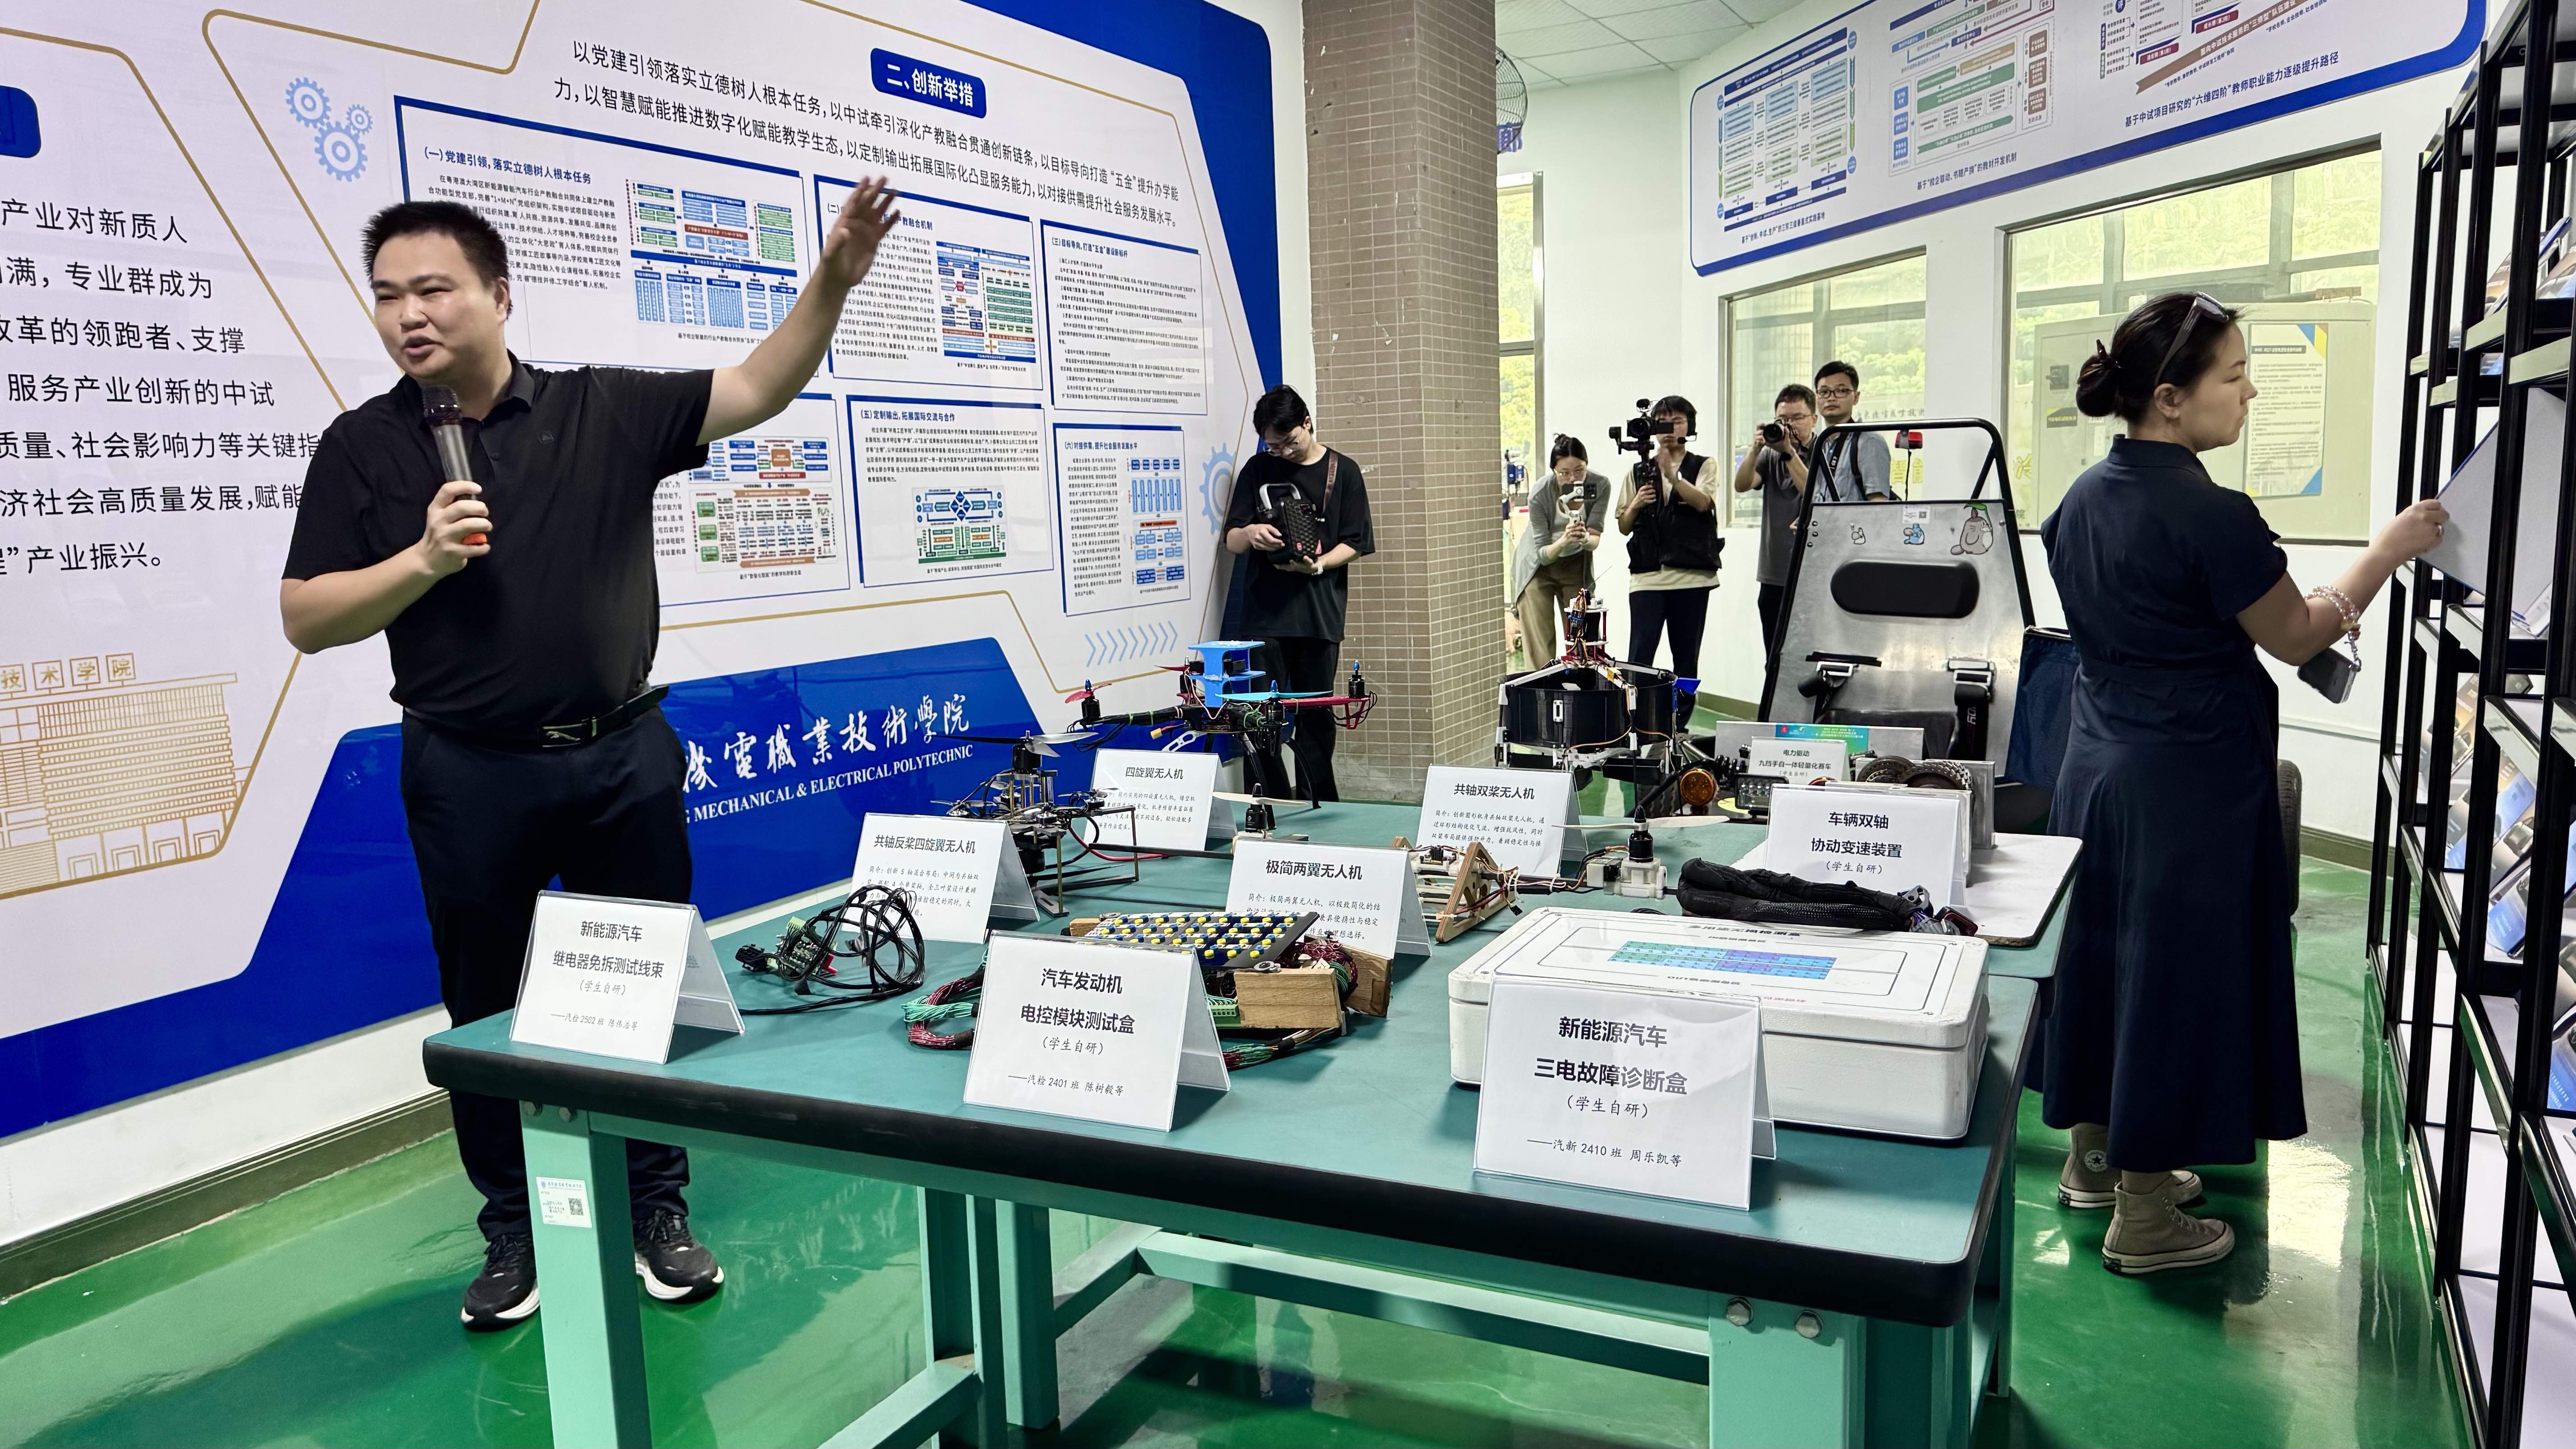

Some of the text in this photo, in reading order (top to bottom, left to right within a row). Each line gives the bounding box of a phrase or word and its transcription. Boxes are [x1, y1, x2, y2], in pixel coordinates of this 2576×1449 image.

[886, 62, 973, 108] 二、创新举措
[1, 198, 188, 244] 产业对新质人
[0, 257, 212, 299] 满，专业群成为
[8, 374, 275, 406] 服务产业创新的中试
[694, 745, 973, 822] MECHANICAL & ELECTRICAL POLYTECHNIC
[1126, 767, 1183, 780] 四旋翼无人机
[1454, 783, 1535, 800] 共轴双桨无人机
[1828, 812, 1889, 829] 车辆双轴
[874, 834, 976, 854] 共轴反桨四旋翼无人机
[1811, 837, 1902, 858] 协动变速装置
[1266, 859, 1362, 880] 极简两翼无人机
[1826, 861, 1882, 874] （学生自研）
[580, 920, 642, 942] 新能源汽车
[552, 950, 664, 978] 继电器免拆测试线束
[580, 980, 626, 995] （学生自研）
[1041, 968, 1122, 994] 汽车发动机
[580, 1016, 596, 1025] 2502
[1021, 1004, 1136, 1034] 电控模块测试盒
[1559, 1016, 1667, 1048] 新能源汽车
[1043, 1036, 1104, 1055] （学生自研）
[1049, 1077, 1067, 1089] 2401
[1072, 1081, 1079, 1090] 班
[1085, 1082, 1124, 1097] 陈树毅等
[1534, 1058, 1688, 1095] 三电故障诊断盒
[1568, 1095, 1648, 1118] （学生自研）
[1582, 1144, 1606, 1157] 2410
[1610, 1147, 1622, 1159] 班
[1630, 1149, 1682, 1168] 周乐凯等
